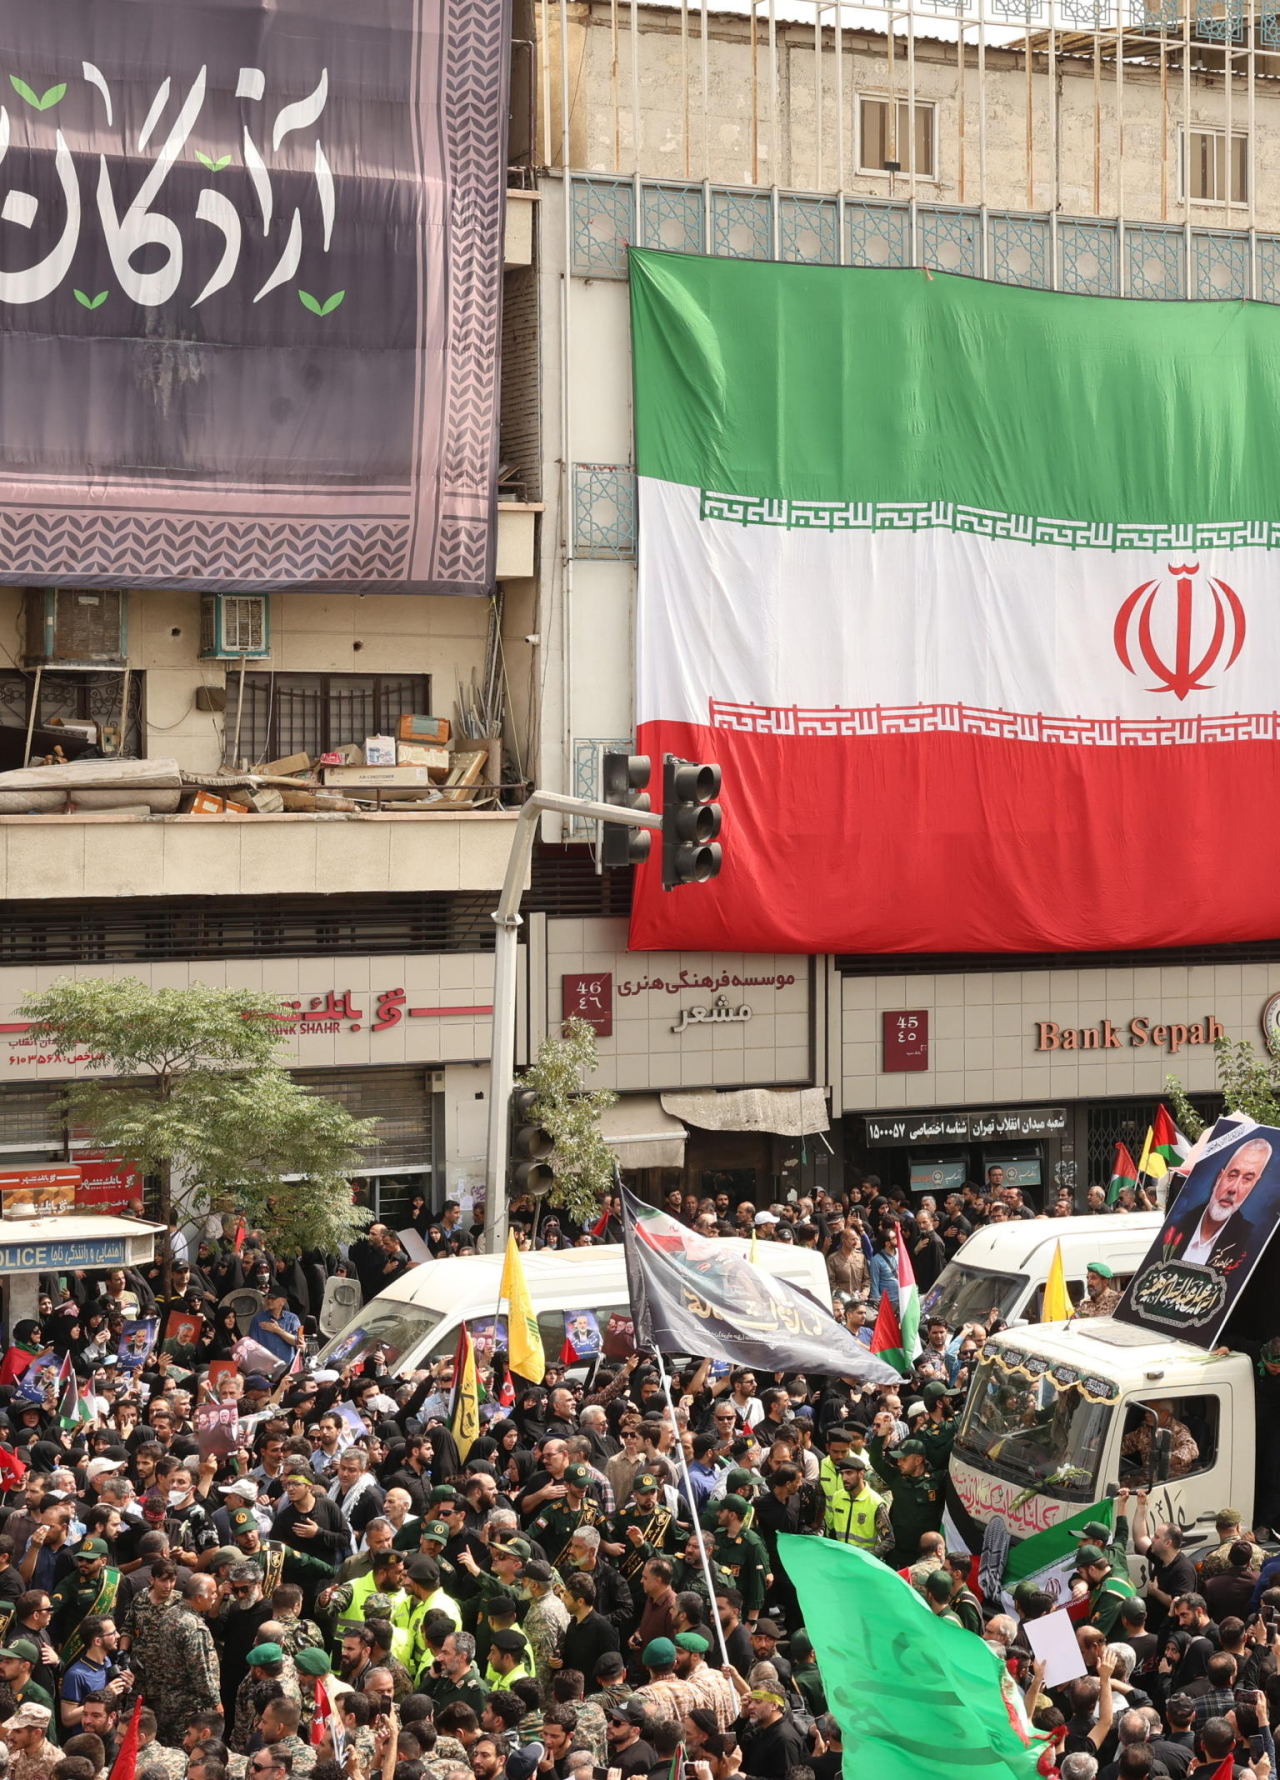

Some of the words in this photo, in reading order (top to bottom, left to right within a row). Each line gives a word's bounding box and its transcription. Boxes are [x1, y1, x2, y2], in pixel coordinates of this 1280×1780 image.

[576, 982, 602, 995] 46
[617, 974, 665, 997] هنری
[666, 969, 731, 994] فرهنگی
[732, 973, 795, 990] موسسه
[671, 994, 753, 1033] مشعر
[896, 1015, 919, 1029] 45
[267, 1023, 297, 1035] ANK
[299, 1021, 341, 1034] SHAHR
[1036, 1019, 1124, 1051] Bank
[1129, 1014, 1225, 1054] Sepah
[945, 1120, 967, 1134] شناسه
[972, 1119, 995, 1136] تهران
[996, 1116, 1021, 1133] انقلاب
[1022, 1117, 1046, 1134] میدان
[1046, 1115, 1065, 1128] شعبه
[909, 1122, 945, 1140] اختصاصی
[51, 1246, 64, 1264] ناجا
[65, 1244, 89, 1265] رانندگی
[96, 1242, 124, 1262] راهنمایی
